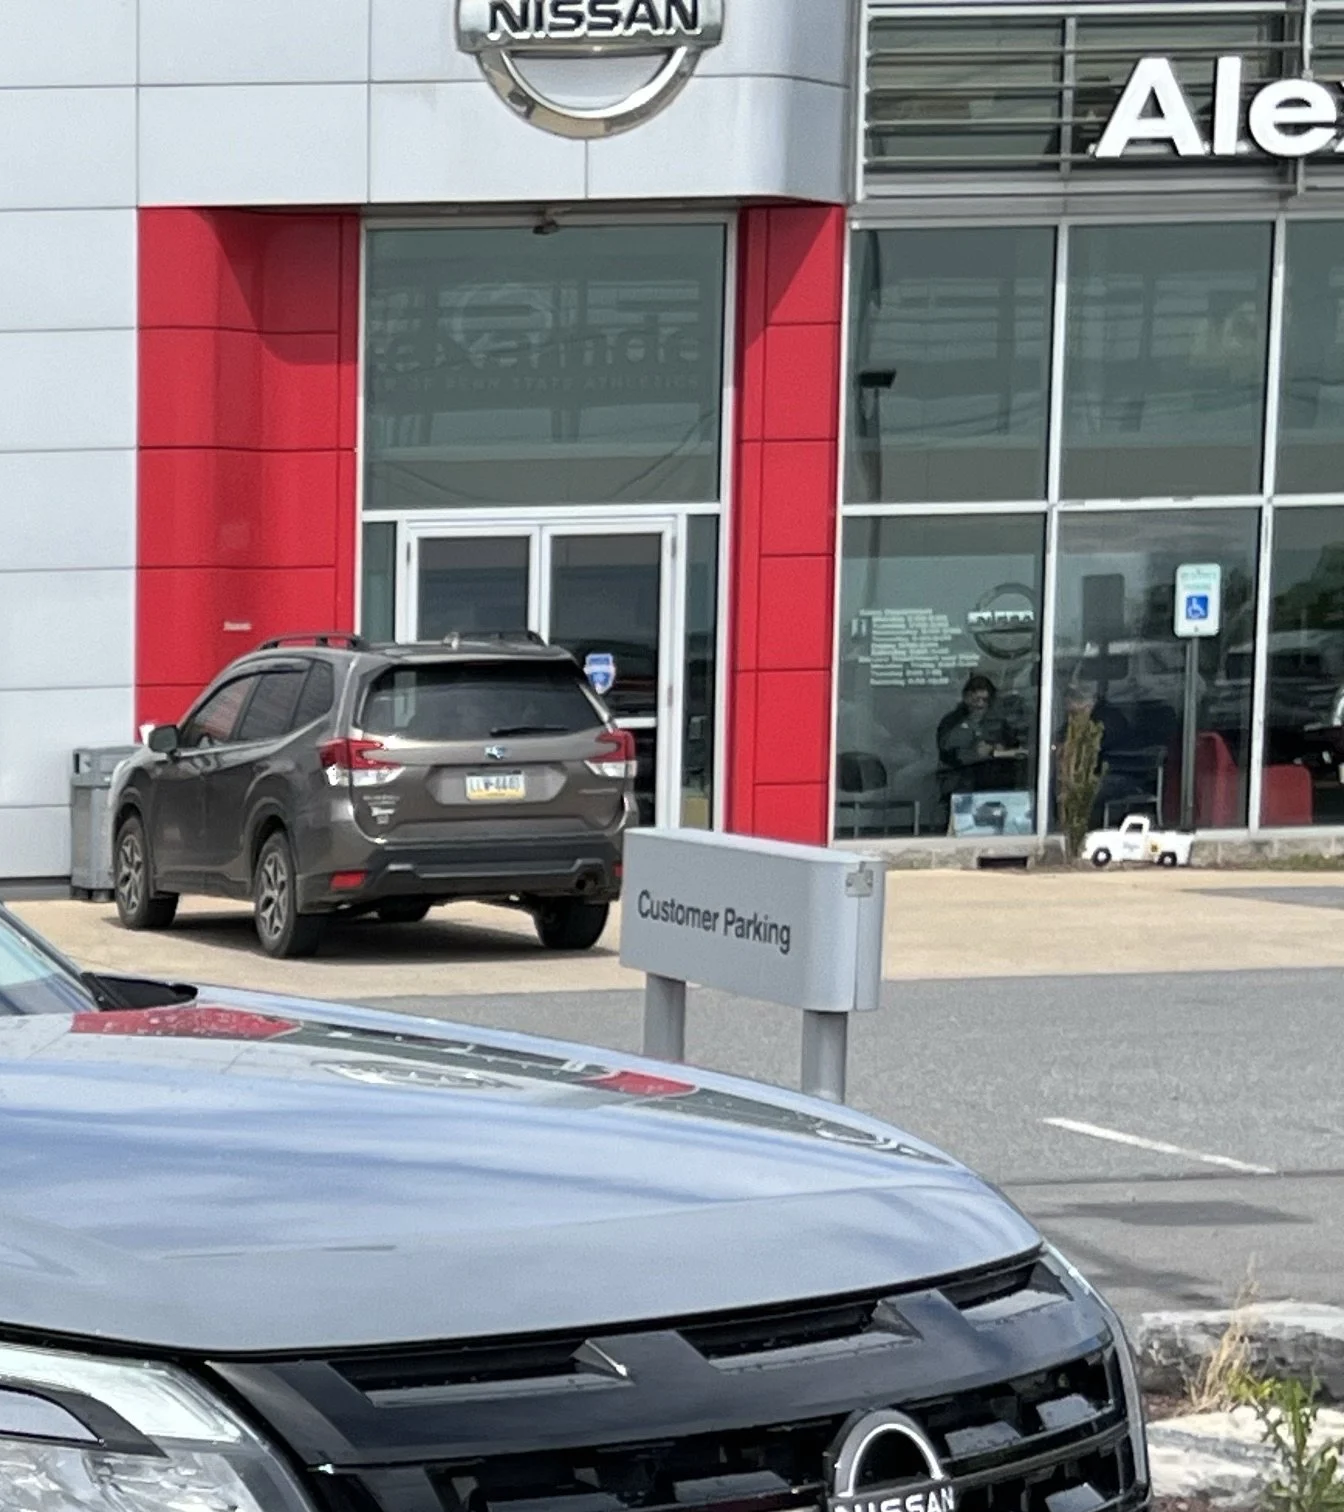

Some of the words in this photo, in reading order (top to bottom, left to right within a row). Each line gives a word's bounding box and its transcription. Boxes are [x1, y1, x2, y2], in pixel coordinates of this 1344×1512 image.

[487, 0, 701, 40] NISSAN
[1096, 56, 1344, 157] Ale
[637, 889, 719, 932] Customer
[723, 907, 791, 955] Parking
